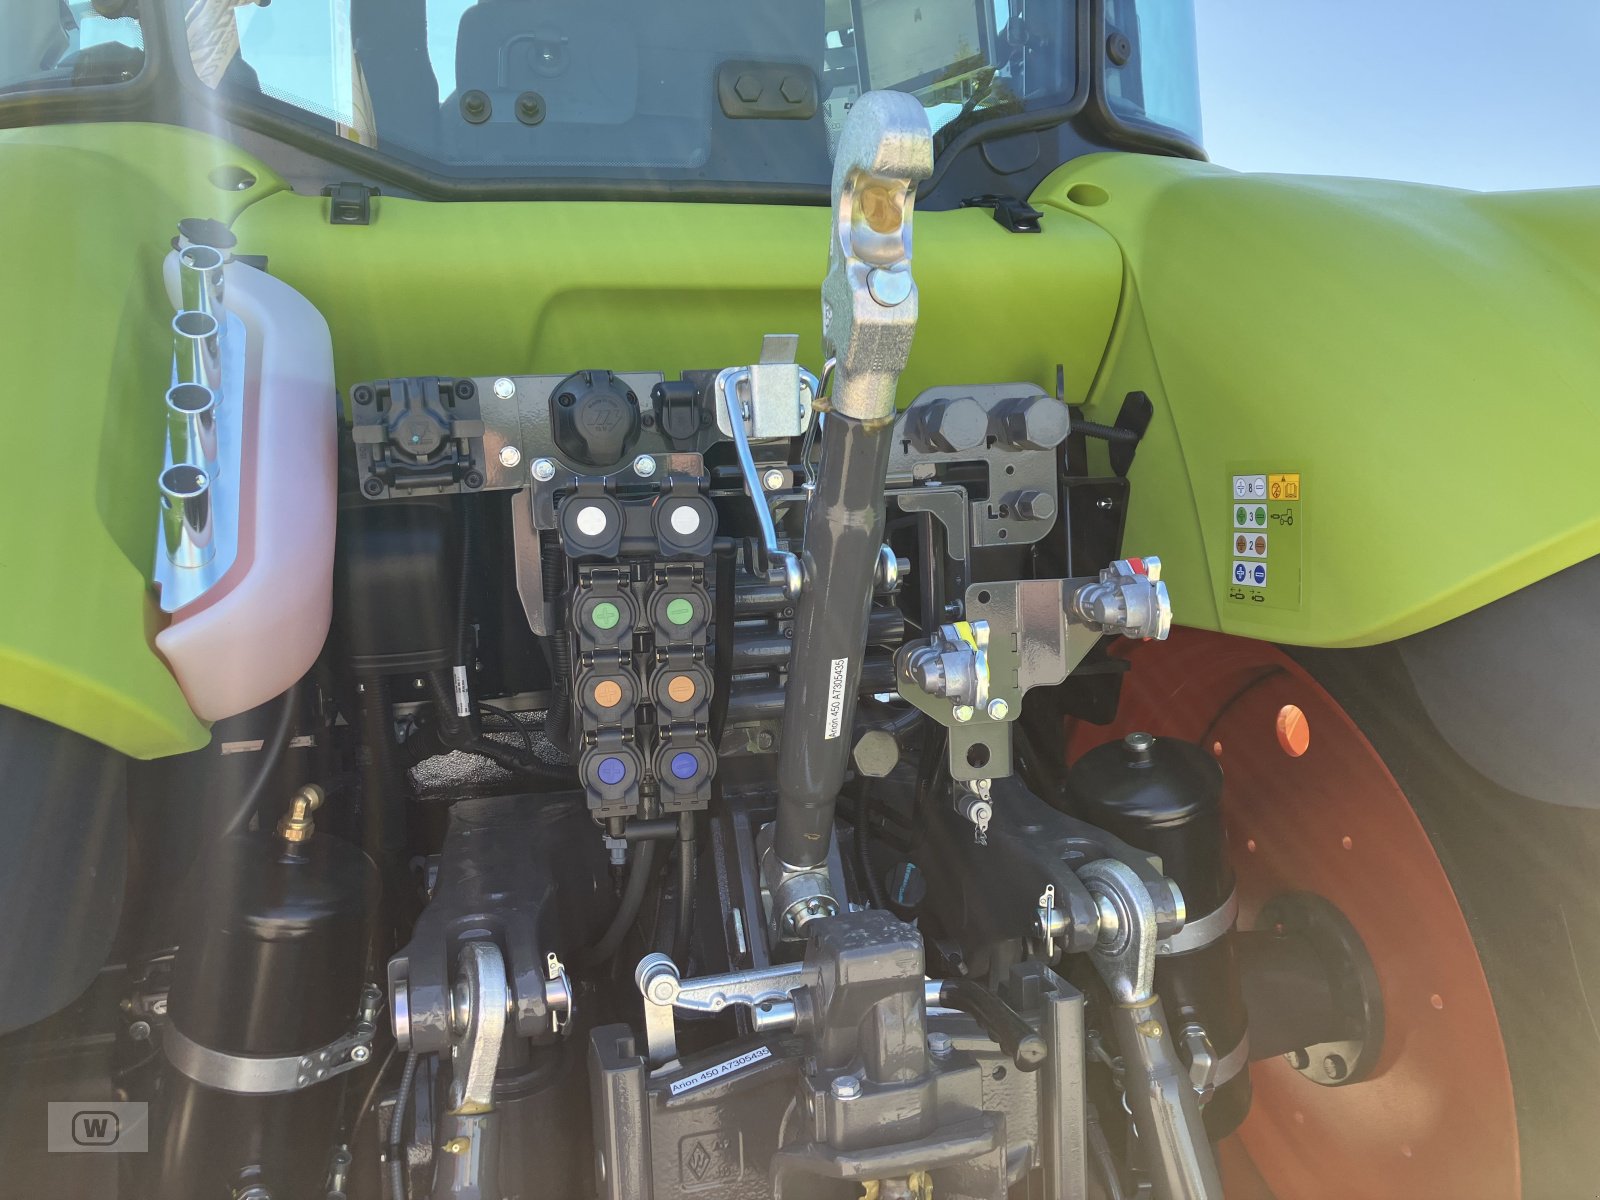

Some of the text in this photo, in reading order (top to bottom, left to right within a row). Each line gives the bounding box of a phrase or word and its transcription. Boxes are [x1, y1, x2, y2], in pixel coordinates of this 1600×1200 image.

[900, 439, 911, 454] T
[986, 435, 997, 450] P
[1248, 483, 1253, 493] 8
[987, 504, 1010, 519] LS
[1249, 512, 1254, 522] 3
[1249, 540, 1254, 551] 2
[832, 659, 845, 700] A7305435
[831, 701, 841, 717] 450
[672, 1048, 770, 1092] Arion 450 A7305435
